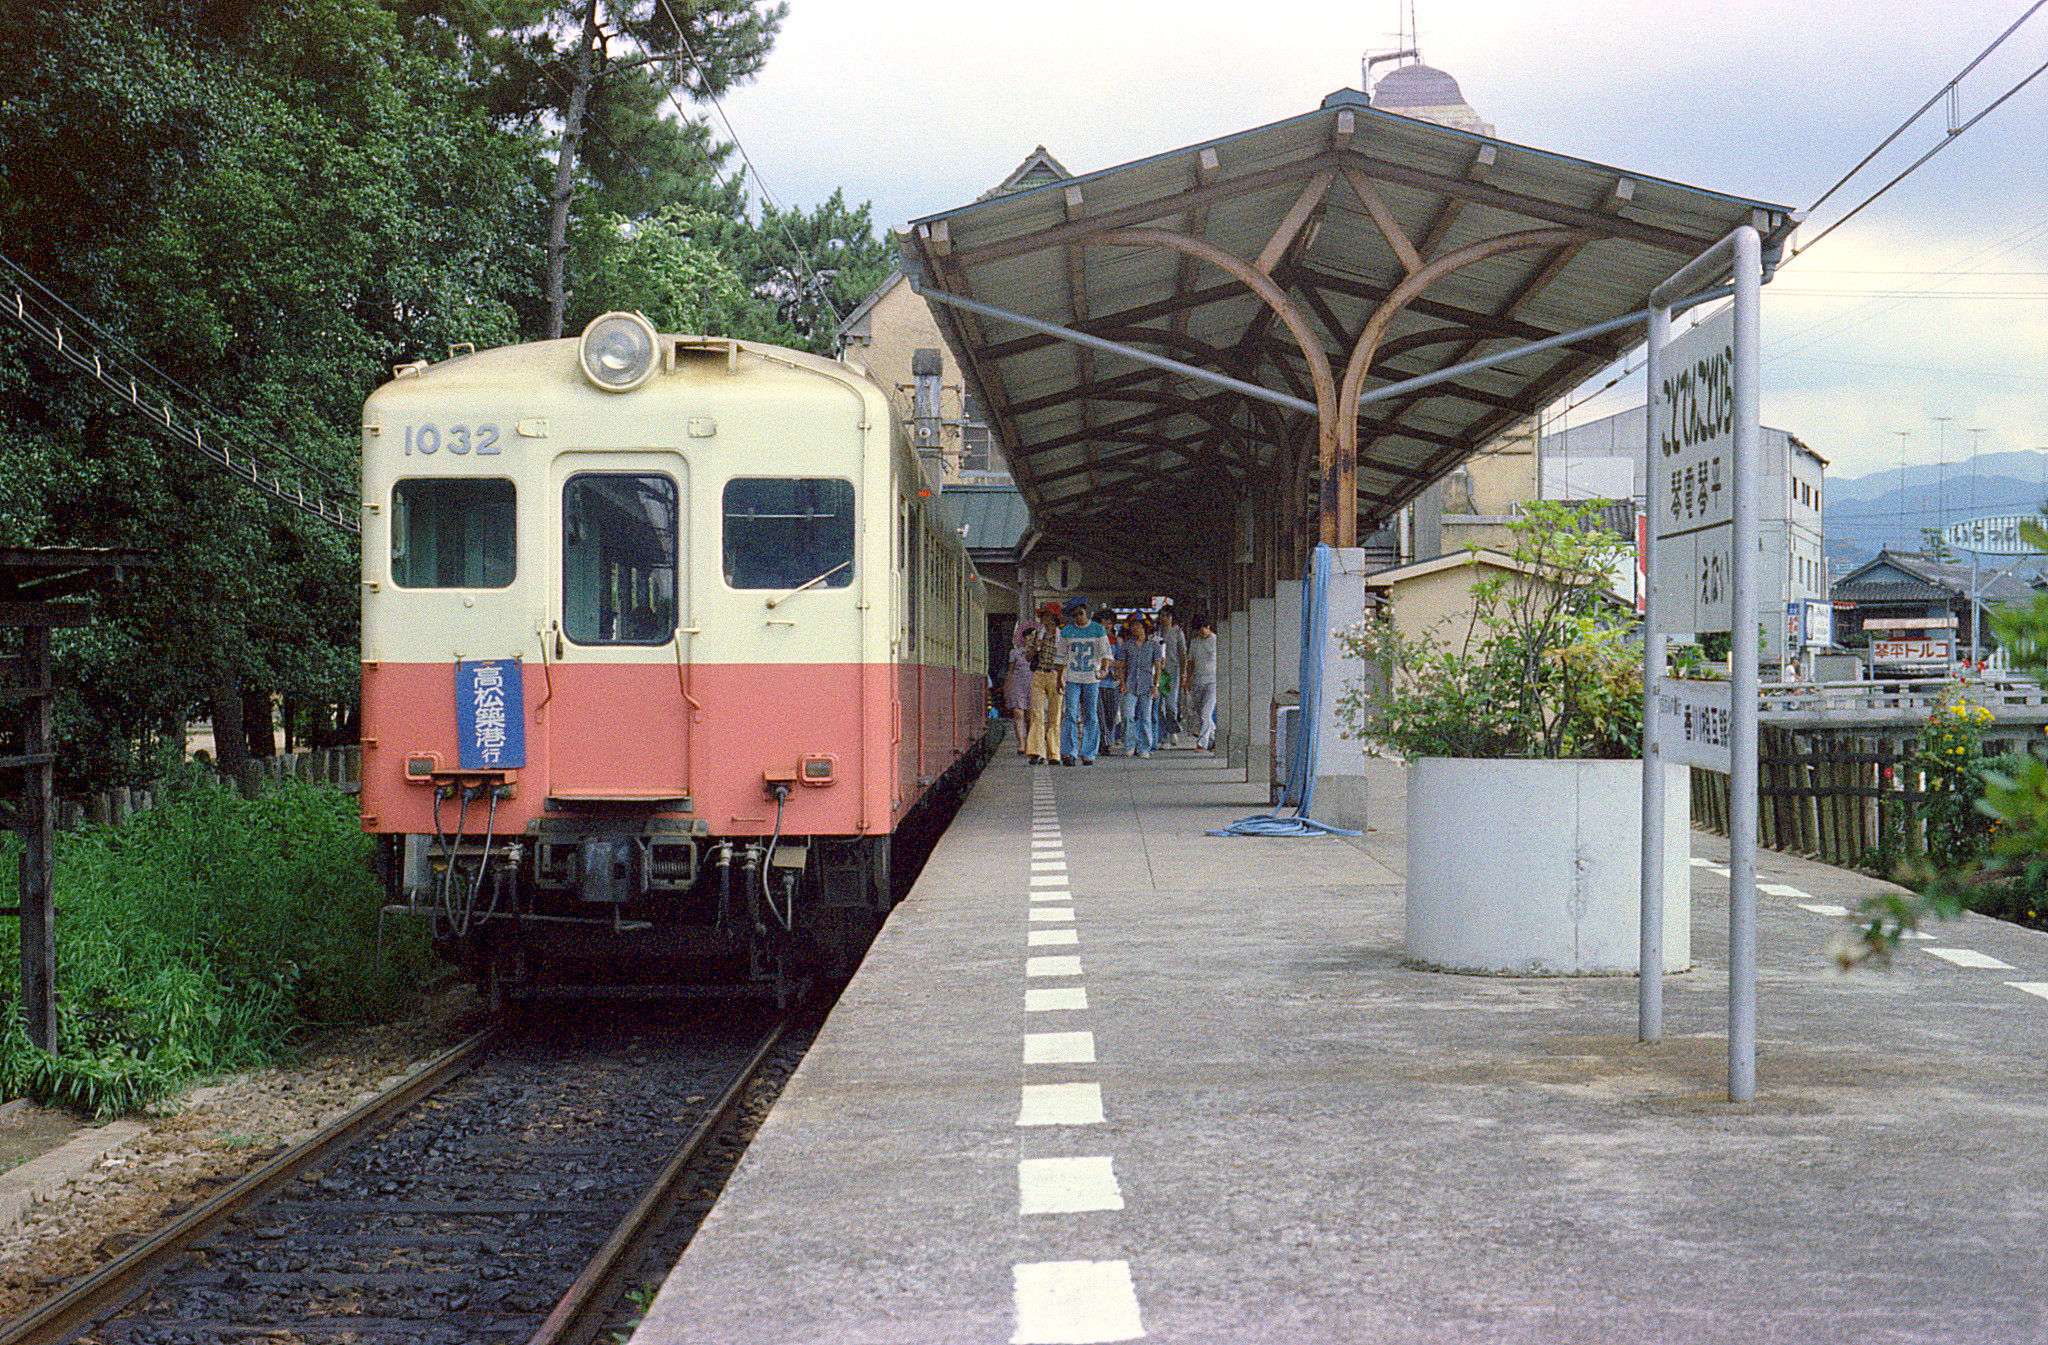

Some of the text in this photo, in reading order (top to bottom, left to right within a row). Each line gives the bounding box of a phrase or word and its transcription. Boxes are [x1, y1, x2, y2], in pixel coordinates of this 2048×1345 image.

[405, 423, 501, 456] 1032
[1671, 457, 1722, 520] 琴電琴平
[1068, 641, 1097, 673] 32
[1874, 642, 1949, 658] 琴平トルコ
[473, 667, 506, 763] 高松築港行
